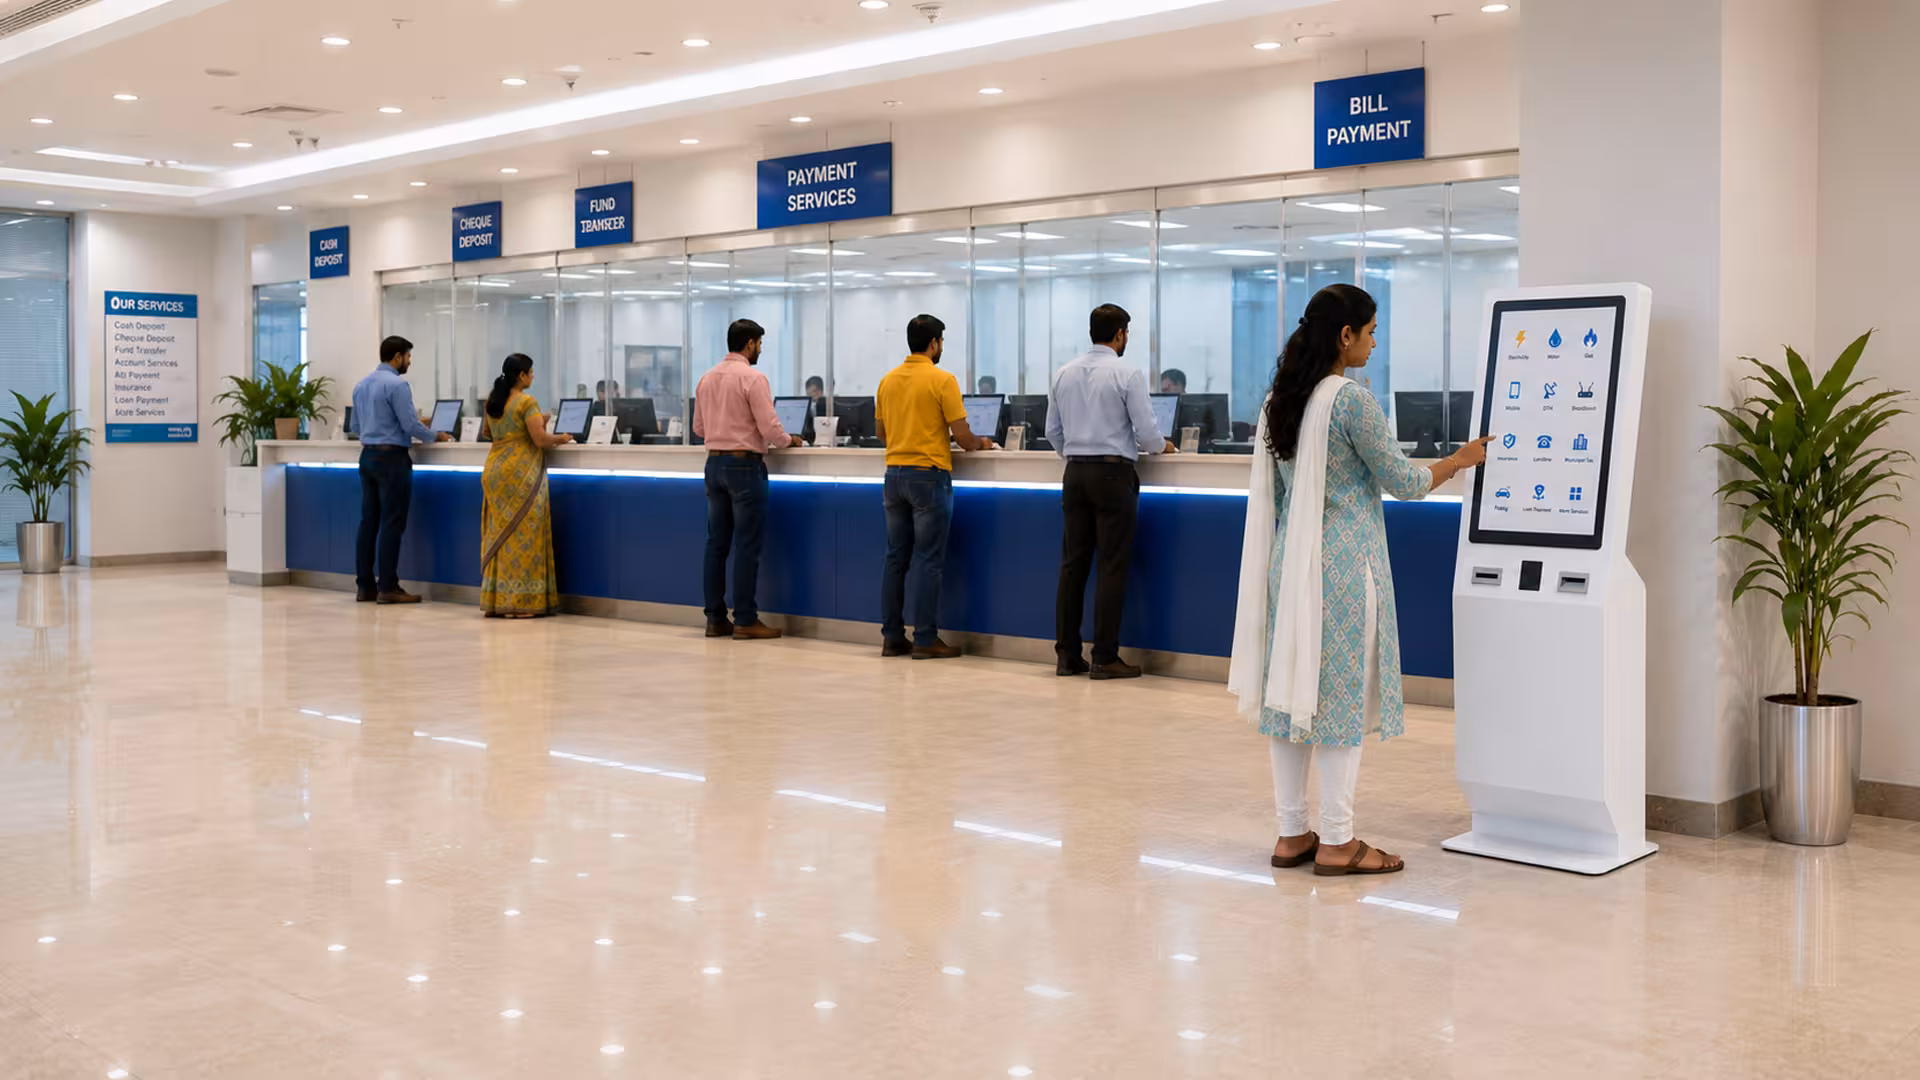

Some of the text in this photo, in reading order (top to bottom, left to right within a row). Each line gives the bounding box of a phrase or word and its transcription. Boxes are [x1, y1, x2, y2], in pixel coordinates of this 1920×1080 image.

[1349, 93, 1389, 115] BILL
[1327, 119, 1412, 146] PAYMENT
[787, 161, 857, 187] PAYMENT
[590, 197, 616, 213] FUND
[787, 187, 857, 212] SERVICES
[460, 214, 492, 230] CHEQUE
[459, 232, 493, 249] DEPOSIT
[137, 299, 184, 313] SERVICES
